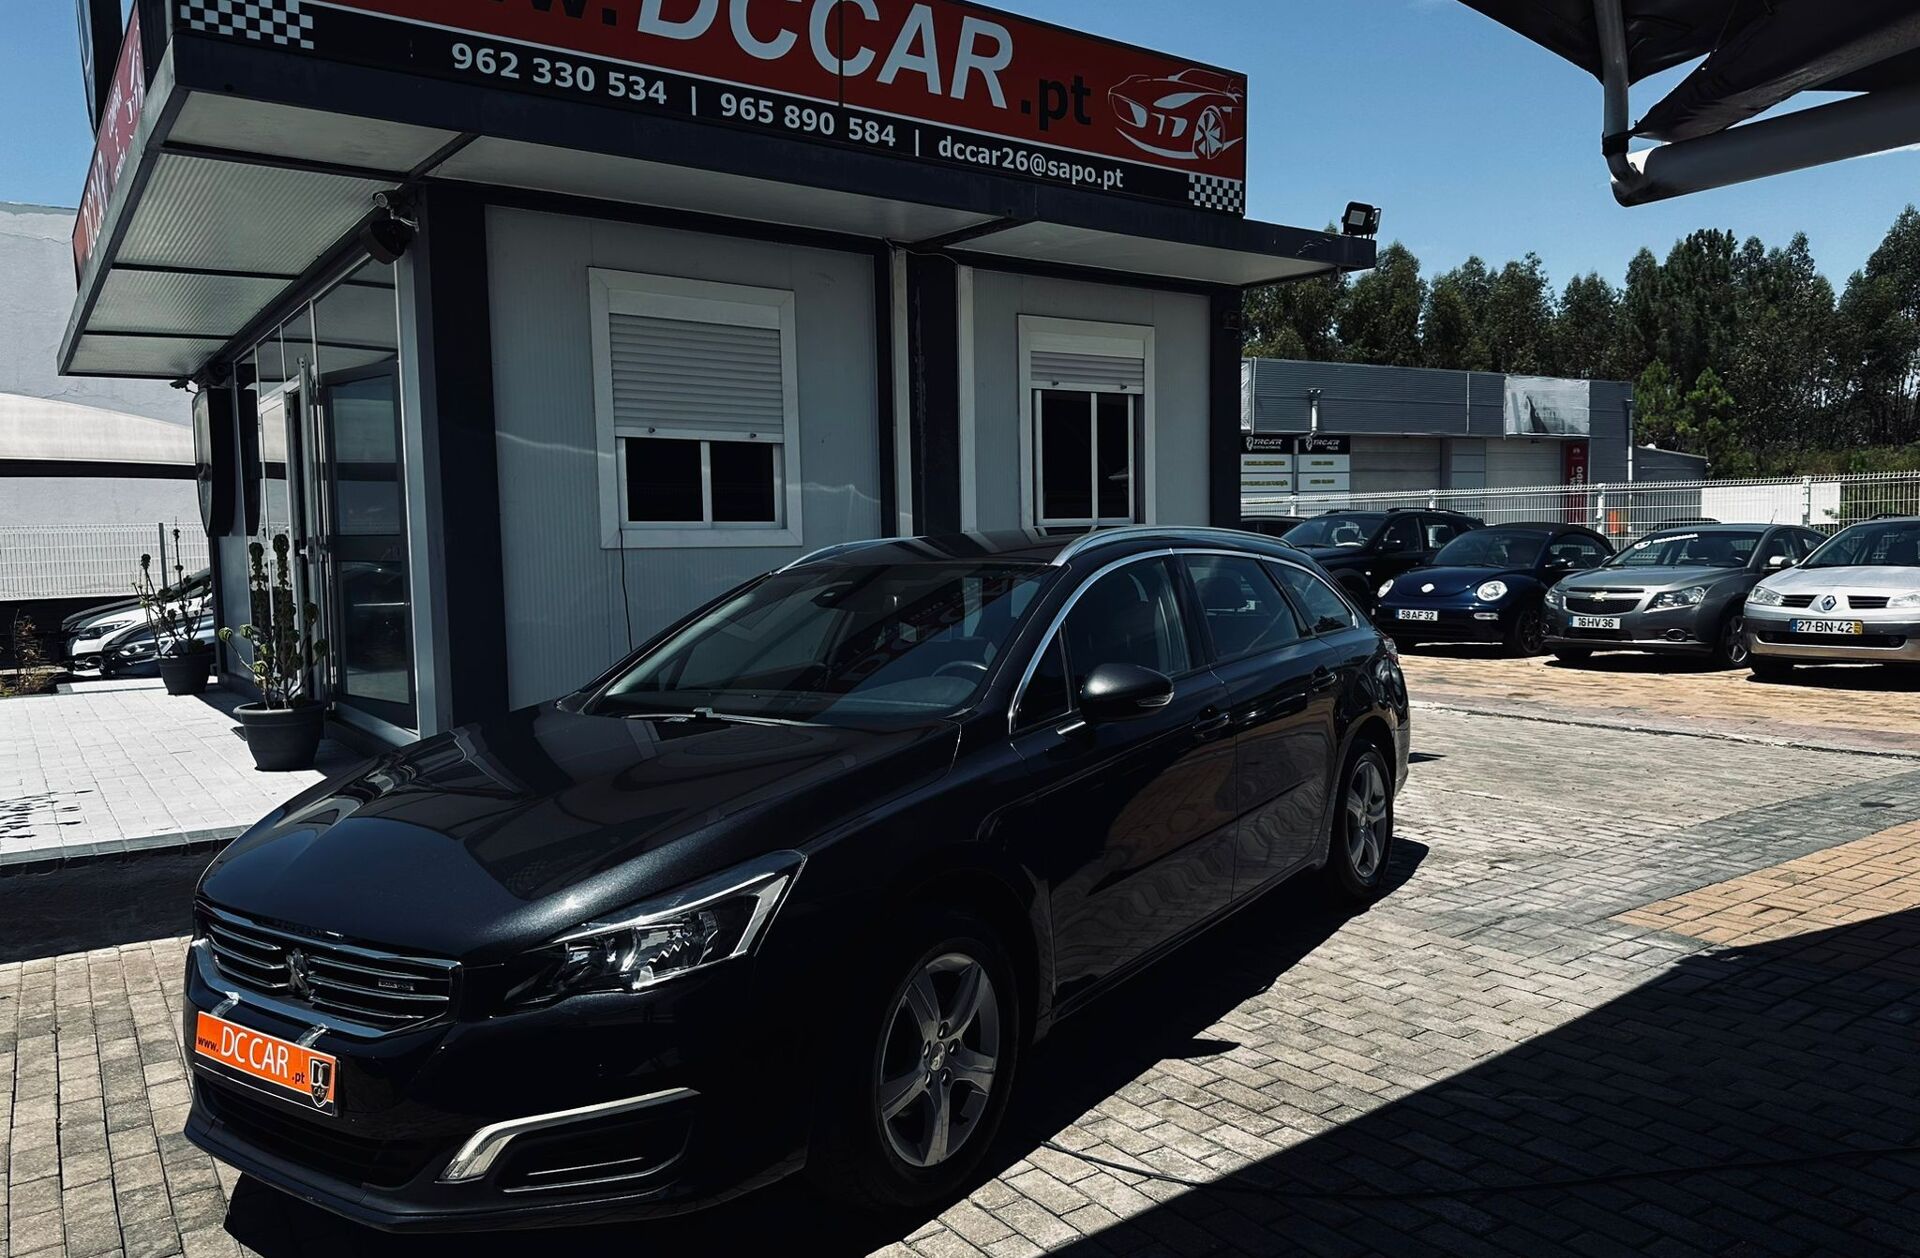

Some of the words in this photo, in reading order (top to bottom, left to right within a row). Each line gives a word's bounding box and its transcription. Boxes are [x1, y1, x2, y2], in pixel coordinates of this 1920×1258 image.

[451, 42, 520, 80] 962
[532, 57, 596, 92] 330
[607, 71, 668, 105] 534
[720, 93, 774, 124] 965
[783, 104, 836, 136] 890
[848, 116, 897, 147] 584
[938, 135, 1124, 190] dccar26@sapo.pt
